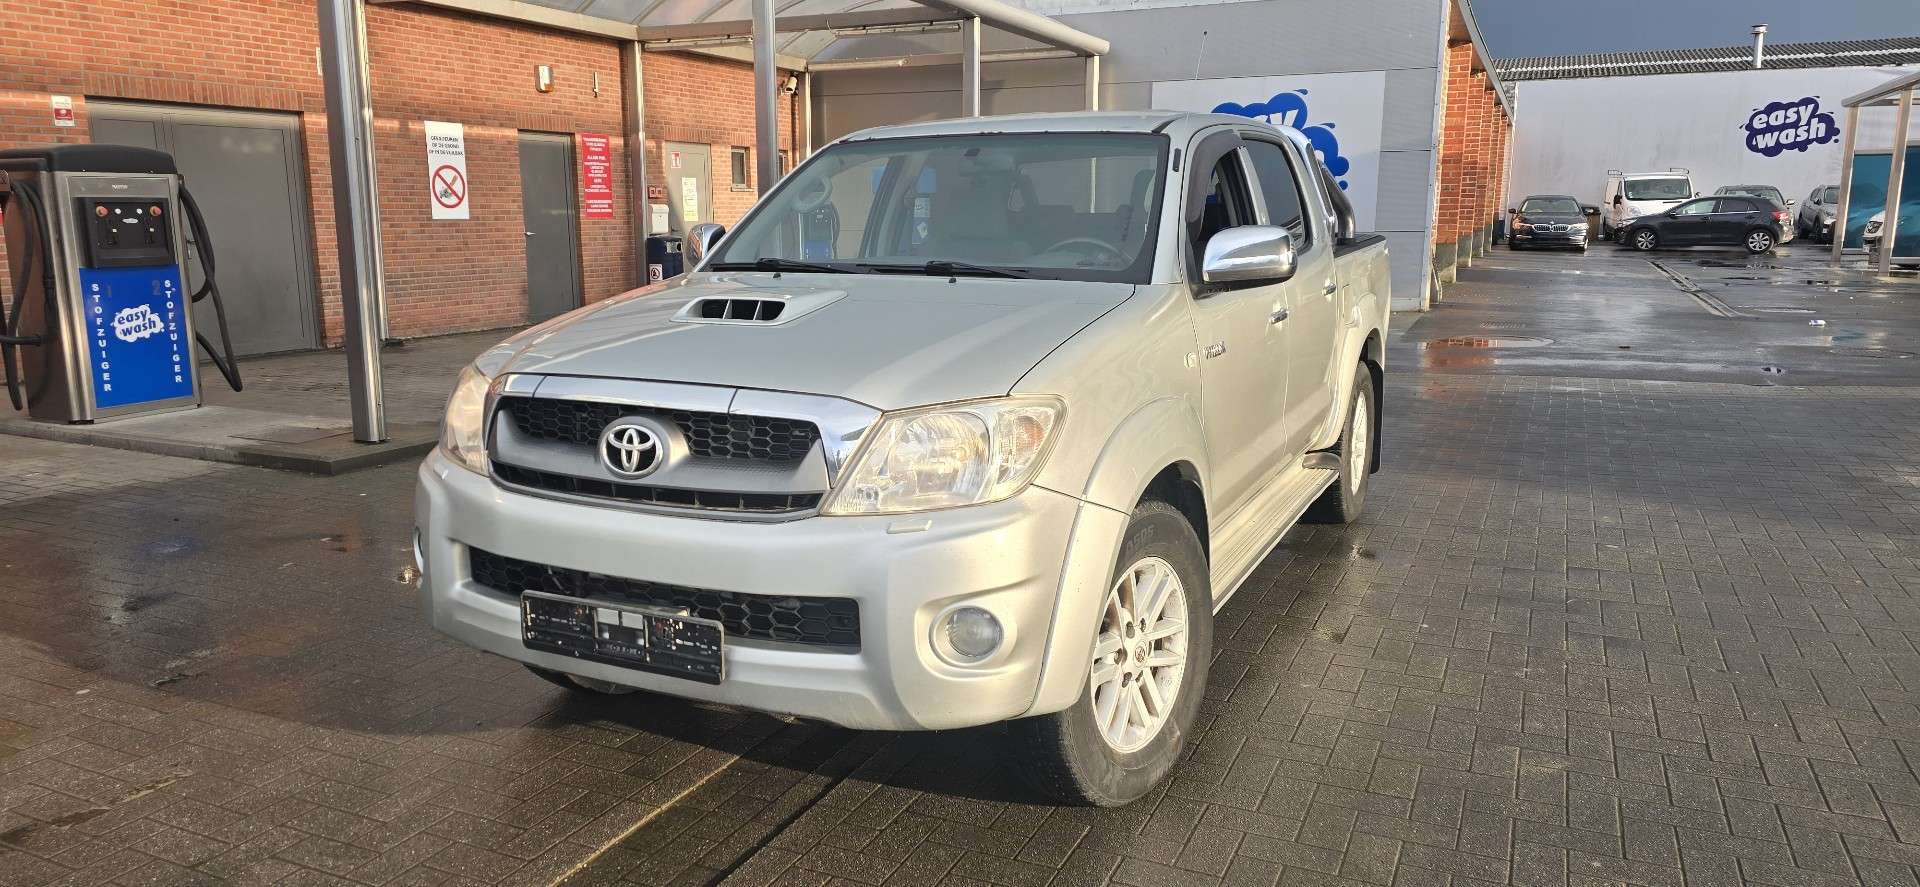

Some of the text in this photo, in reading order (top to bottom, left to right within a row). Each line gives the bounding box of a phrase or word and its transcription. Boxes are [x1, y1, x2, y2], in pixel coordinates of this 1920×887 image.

[1752, 103, 1815, 129] easy
[1756, 117, 1826, 149] wash
[118, 310, 147, 325] easy
[121, 318, 156, 336] wash
[164, 279, 182, 383] STOFZUIGER
[91, 283, 112, 392] STOFZUIGER
